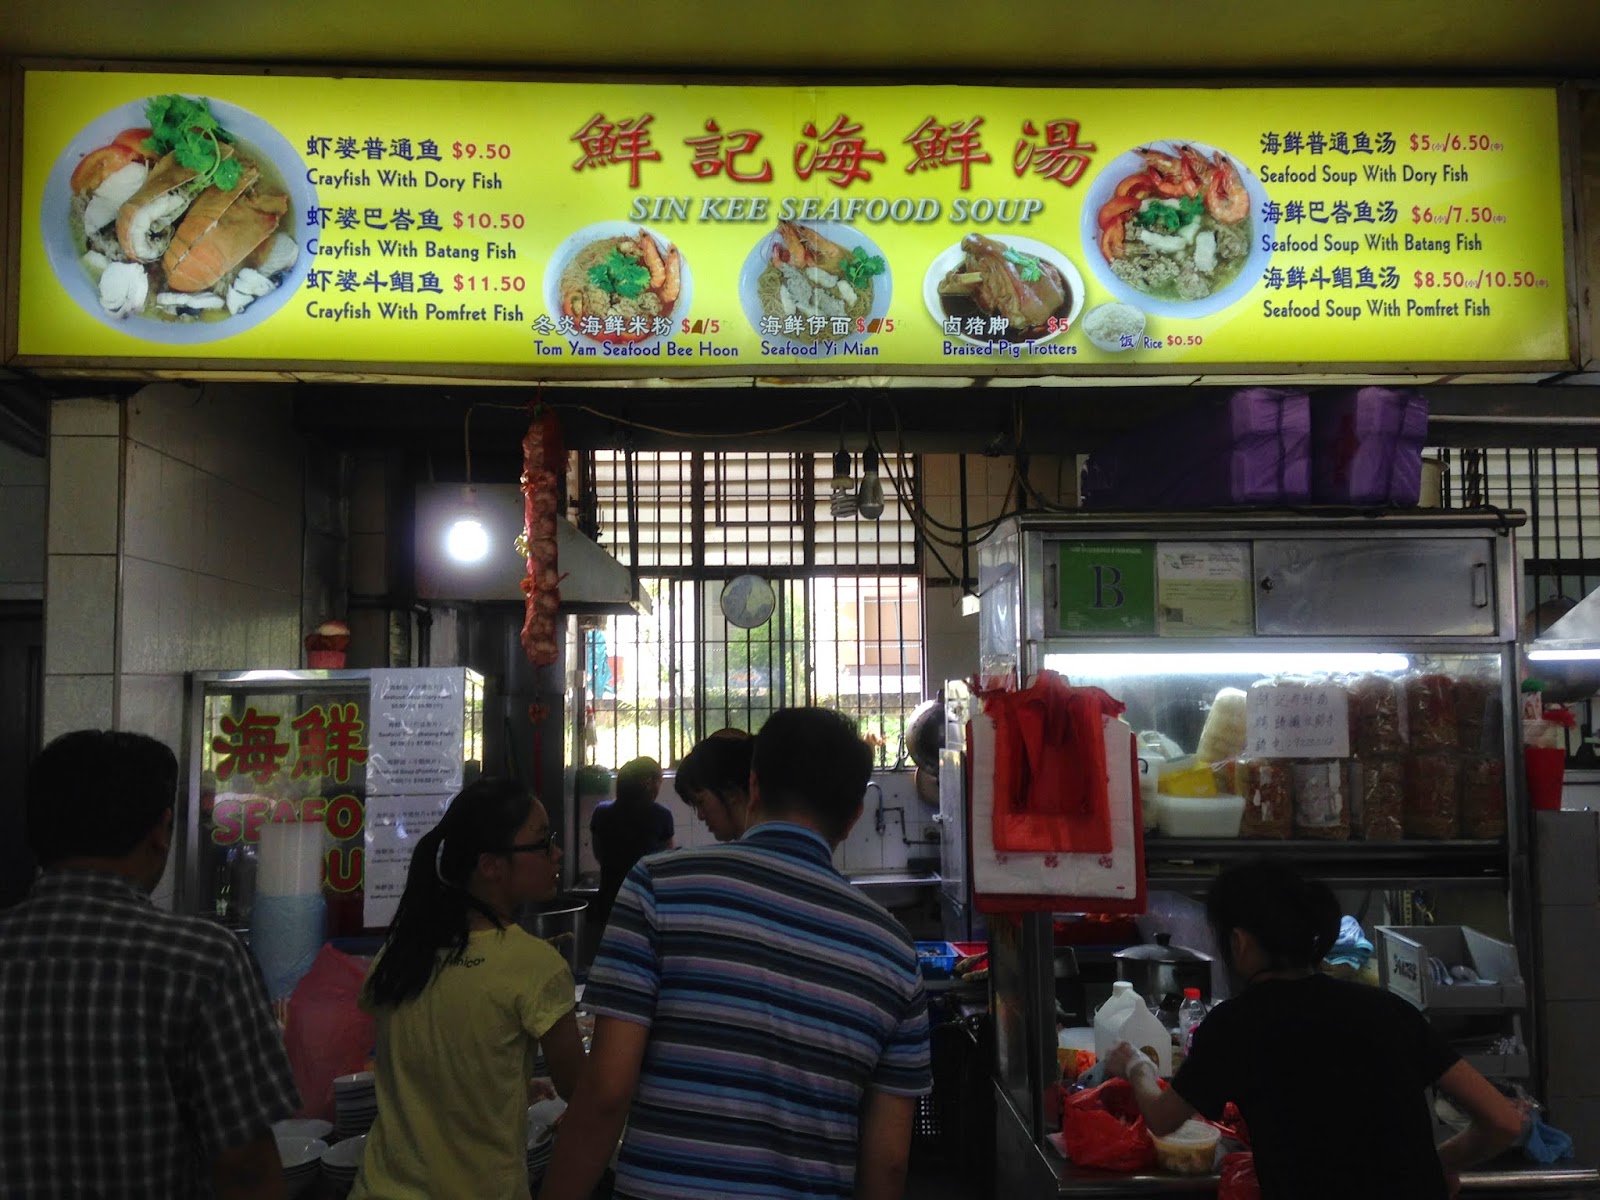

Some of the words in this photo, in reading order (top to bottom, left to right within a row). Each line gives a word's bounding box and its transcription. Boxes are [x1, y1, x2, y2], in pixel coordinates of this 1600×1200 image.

[306, 135, 442, 162] 虾婆普通鱼
[452, 141, 511, 160] $9.50
[570, 113, 1098, 190] 鮮記海鮮湯
[306, 168, 370, 189] Crayfish
[377, 170, 417, 188] With
[425, 171, 466, 192] Dory
[473, 172, 502, 189] Fish
[1260, 165, 1316, 182] Seafood
[1322, 166, 1357, 186] Soup
[1362, 165, 1396, 182] With
[1403, 165, 1436, 186] Dory
[1443, 164, 1468, 182] Fish
[452, 211, 525, 230] $10.50
[629, 195, 690, 222] SIN
[700, 196, 768, 223] KEE
[777, 196, 941, 224] SEAFOOD
[949, 198, 1043, 225] SOUP
[306, 239, 370, 259] Crayfish
[377, 240, 418, 258] With
[426, 242, 479, 262] Batang
[487, 243, 516, 259] Fish
[1262, 235, 1318, 252] Seafood
[1324, 235, 1359, 255] Soup
[1365, 234, 1399, 251] With
[1404, 233, 1450, 254] Batang
[1456, 233, 1482, 251] Fish
[453, 274, 526, 292] $11.50
[306, 301, 371, 322] Crayfish
[377, 303, 418, 320] With
[426, 304, 487, 321] Pomfret
[494, 305, 524, 321] Fish
[1263, 300, 1320, 318] Seafood
[1326, 301, 1361, 321] Soup
[1366, 300, 1400, 317] With
[1407, 299, 1459, 317] Pomfret
[1464, 298, 1490, 317] Fish
[681, 317, 720, 335] $/5
[760, 315, 851, 336] 海鲜伊面
[856, 317, 894, 335] $/5
[943, 315, 1009, 336] 卤猪脚
[1047, 316, 1069, 333] $5
[534, 340, 562, 356] Tom
[568, 341, 596, 356] Yam
[603, 341, 660, 356] Seafood
[667, 342, 693, 356] Bee
[700, 342, 738, 356] Hoon
[761, 340, 817, 356] Seafood
[824, 341, 837, 356] Yi
[844, 341, 879, 356] Mian
[943, 341, 992, 356] Braised
[999, 341, 1020, 359] Pig
[1026, 341, 1077, 356] Trotters
[1167, 335, 1203, 346] $0.50
[1088, 564, 1125, 609] B
